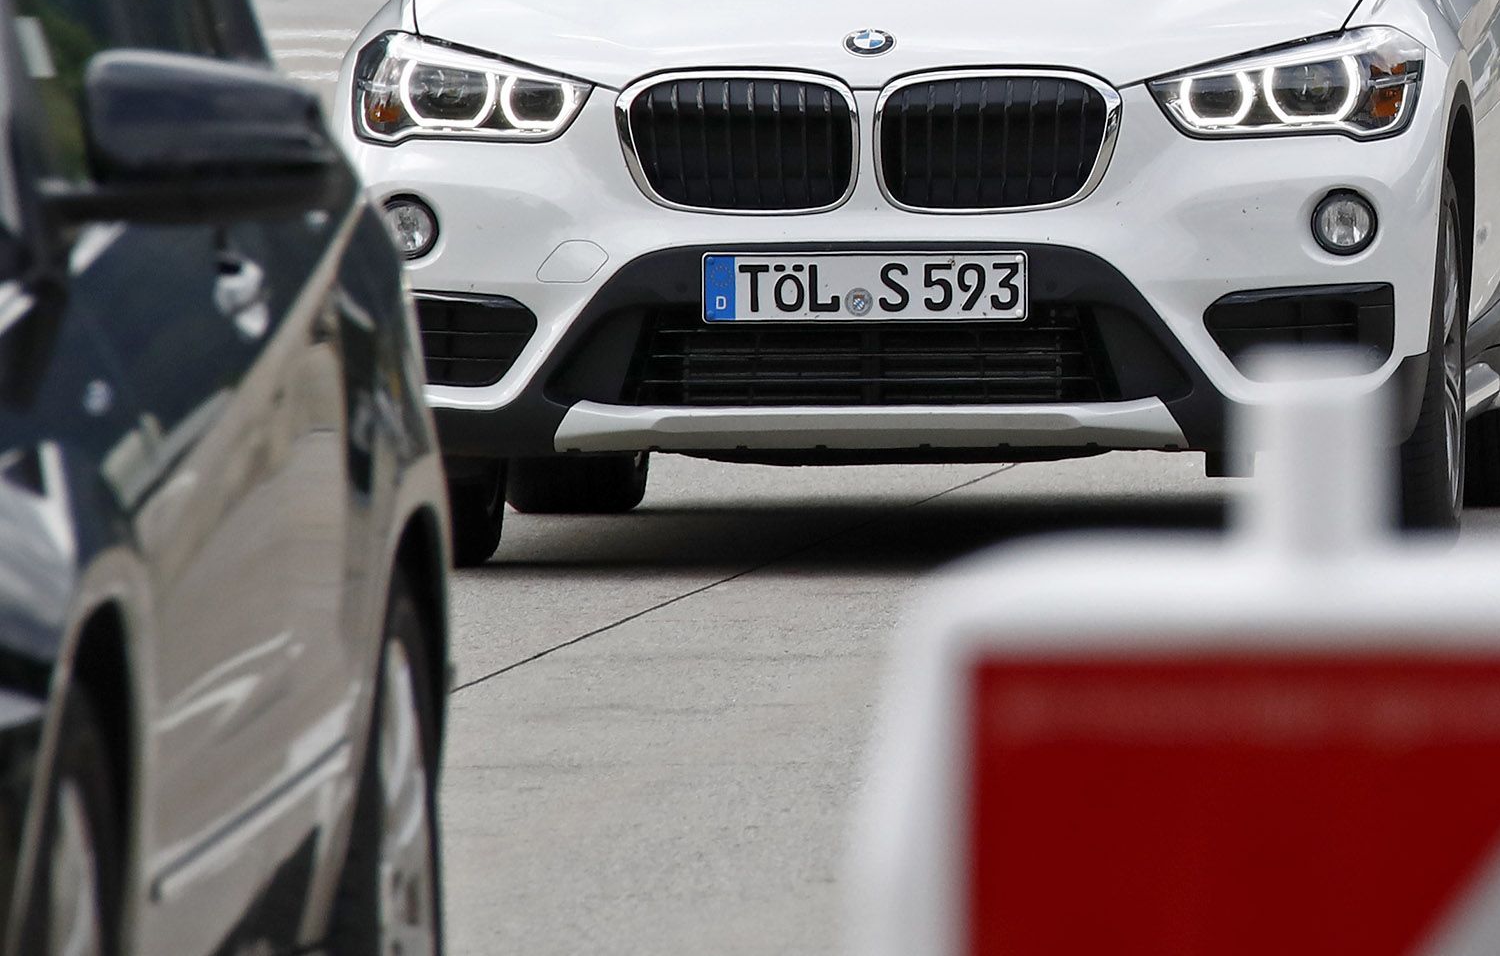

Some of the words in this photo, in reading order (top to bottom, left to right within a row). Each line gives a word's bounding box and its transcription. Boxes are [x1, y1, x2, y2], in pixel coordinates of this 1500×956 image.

[715, 296, 727, 311] D
[738, 263, 841, 313] TÖL
[879, 263, 910, 312] S
[923, 262, 1020, 312] 593
